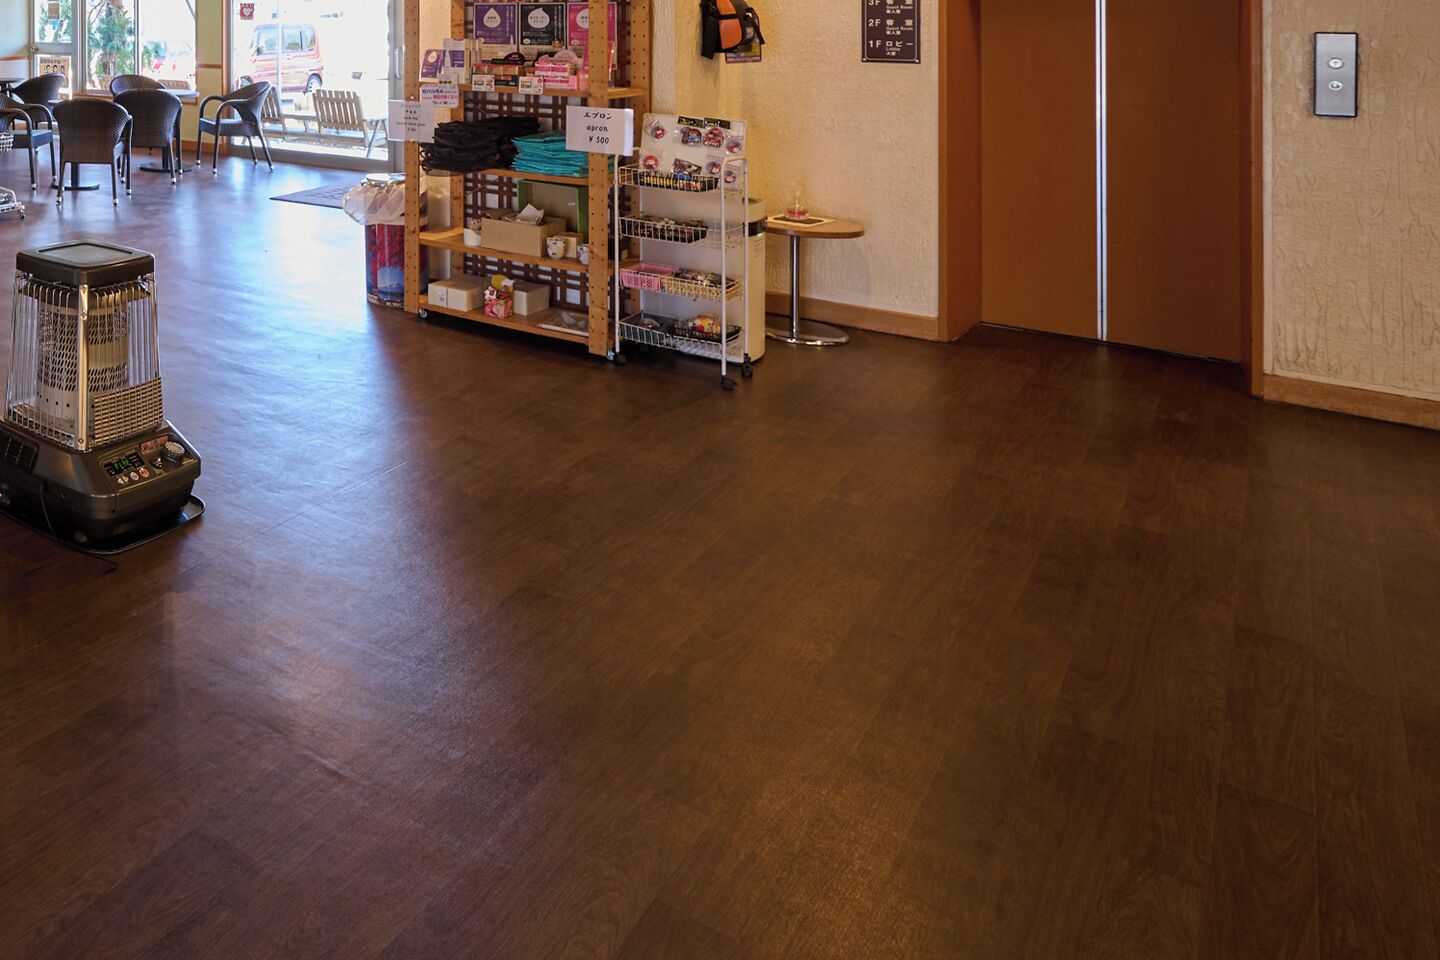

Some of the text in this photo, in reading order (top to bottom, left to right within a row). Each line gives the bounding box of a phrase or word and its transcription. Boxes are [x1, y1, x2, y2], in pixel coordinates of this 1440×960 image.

[868, 19, 881, 27] 2F
[868, 40, 882, 48] 1F
[584, 111, 613, 120] エプロン
